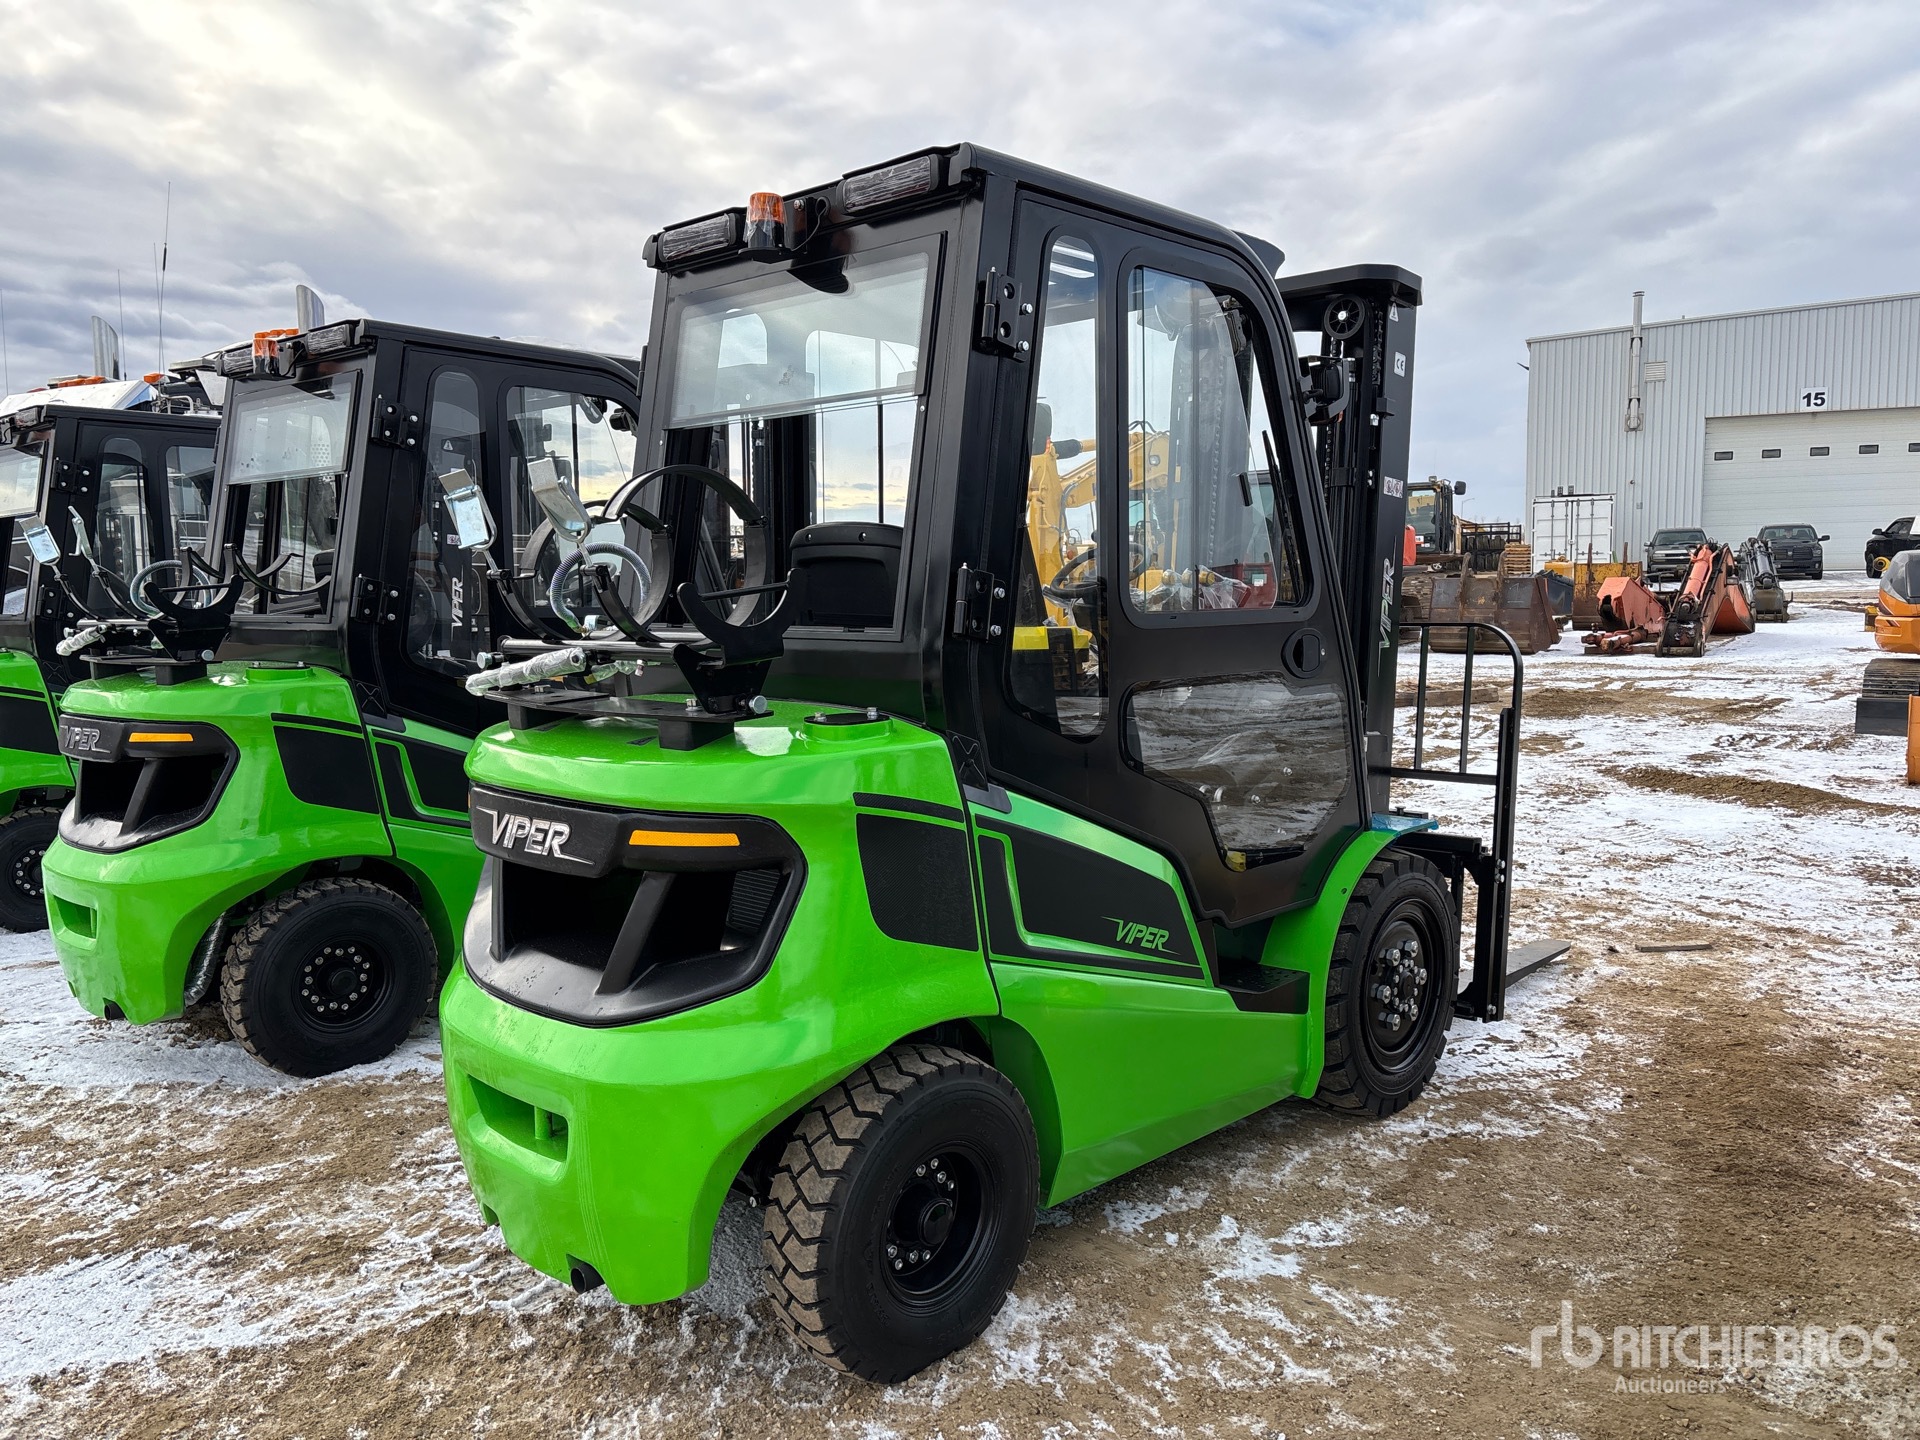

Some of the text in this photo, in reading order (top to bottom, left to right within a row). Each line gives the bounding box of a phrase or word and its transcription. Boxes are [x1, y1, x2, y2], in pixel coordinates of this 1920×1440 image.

[1396, 358, 1405, 372] CE
[1802, 391, 1826, 407] 15
[451, 567, 463, 640] VIPER
[1378, 540, 1396, 672] VIPER
[60, 725, 111, 753] VIPER
[478, 806, 592, 864] VIPER
[1103, 917, 1178, 954] VIPER
